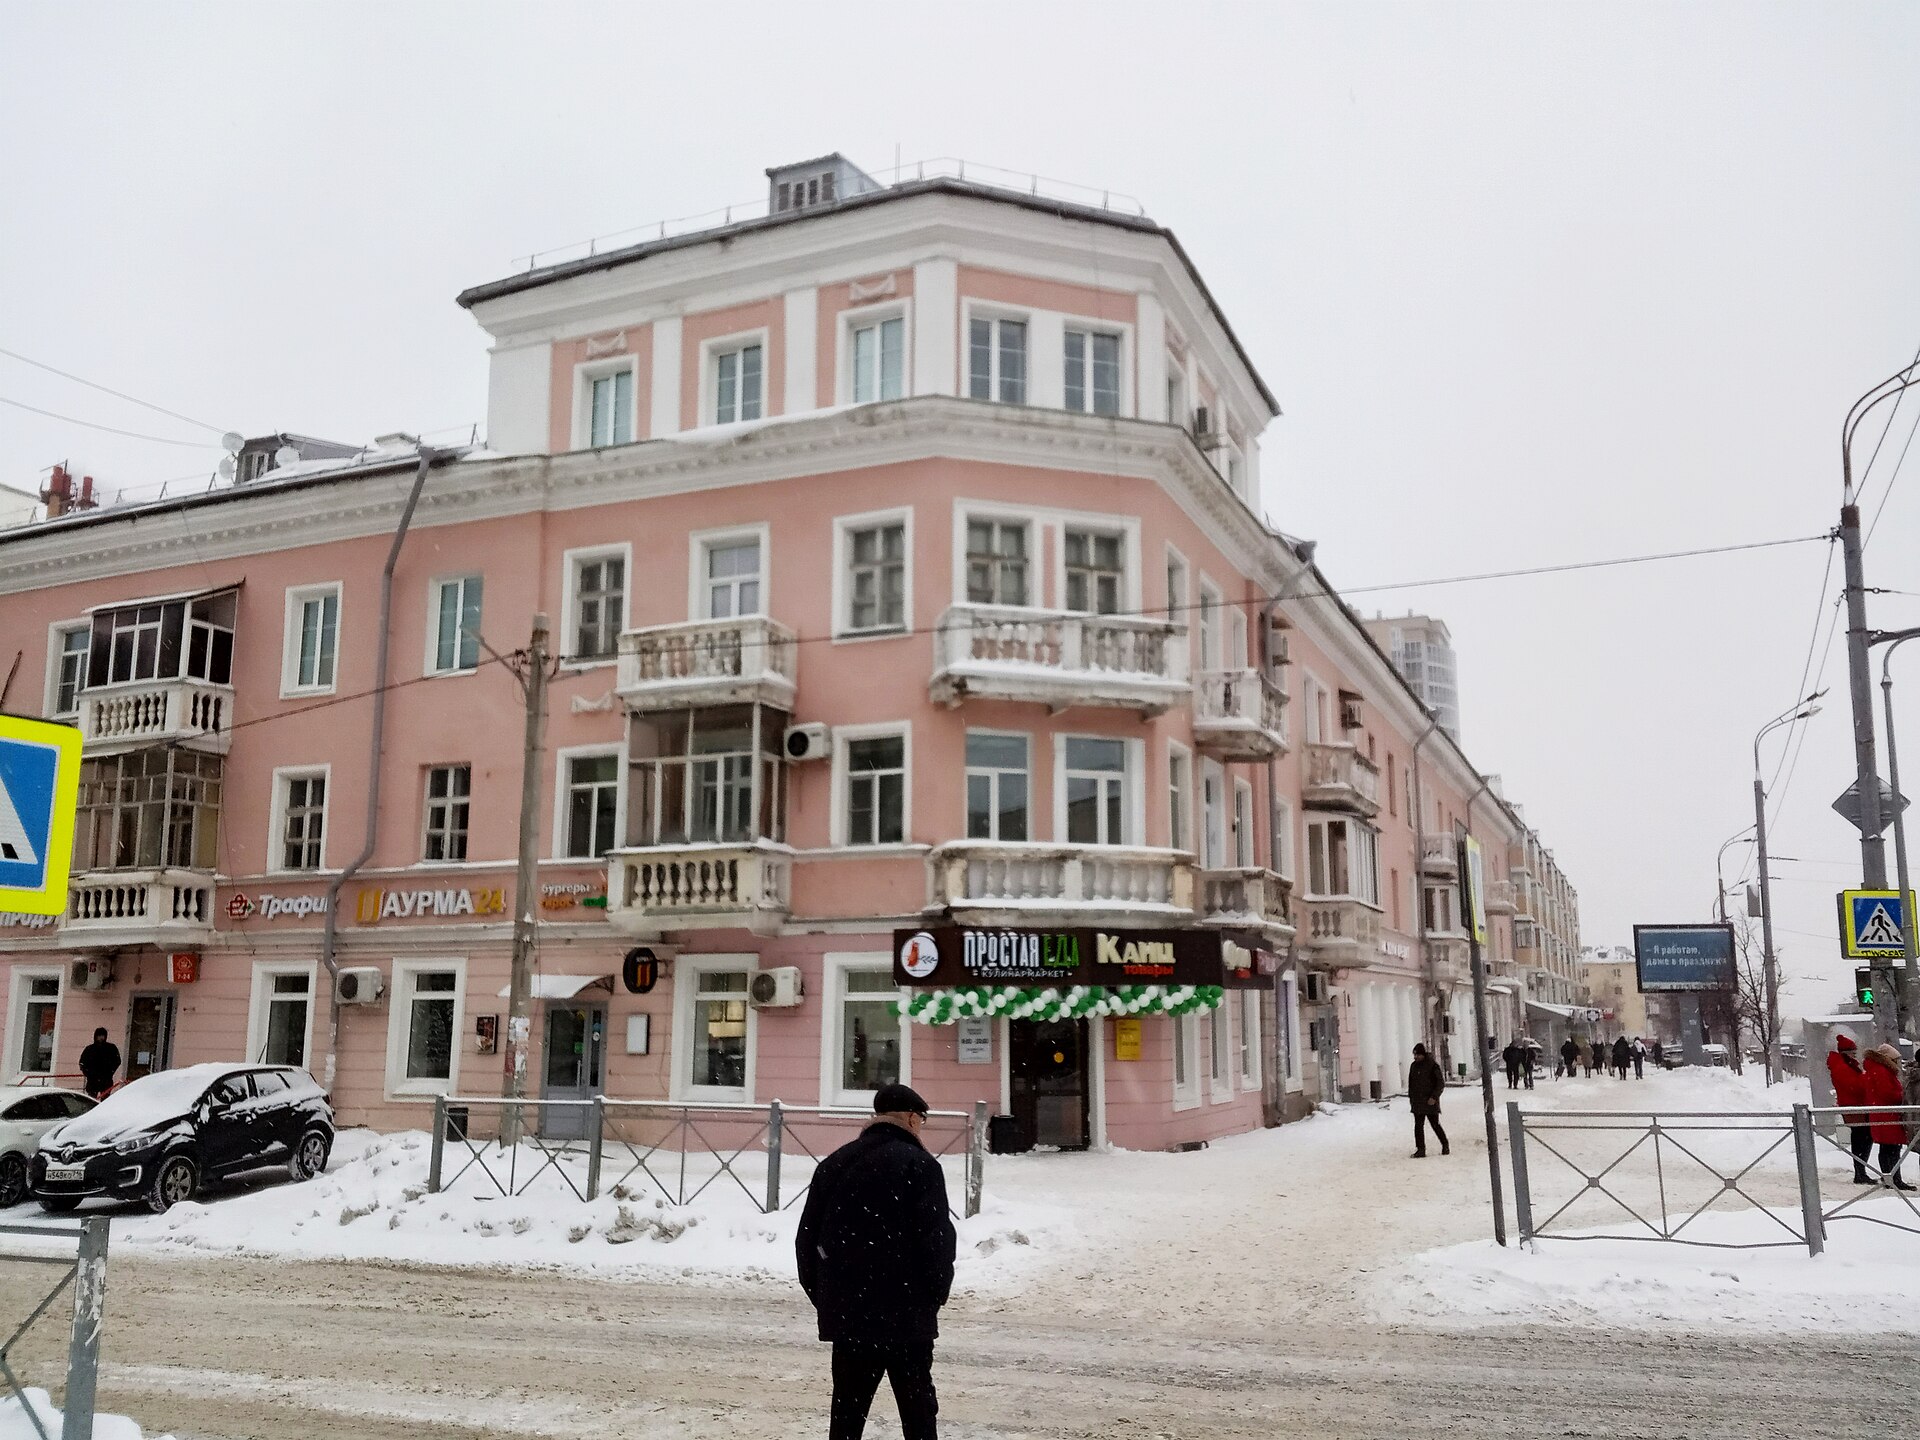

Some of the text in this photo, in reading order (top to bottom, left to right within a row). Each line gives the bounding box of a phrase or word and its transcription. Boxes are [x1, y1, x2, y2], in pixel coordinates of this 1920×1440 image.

[542, 883, 590, 896] бургеры
[259, 894, 338, 920] Трафи
[963, 933, 1080, 968] ПРОСТАЯ ЕДА
[981, 968, 1065, 979] КУЛИНАРМАРКЕТ
